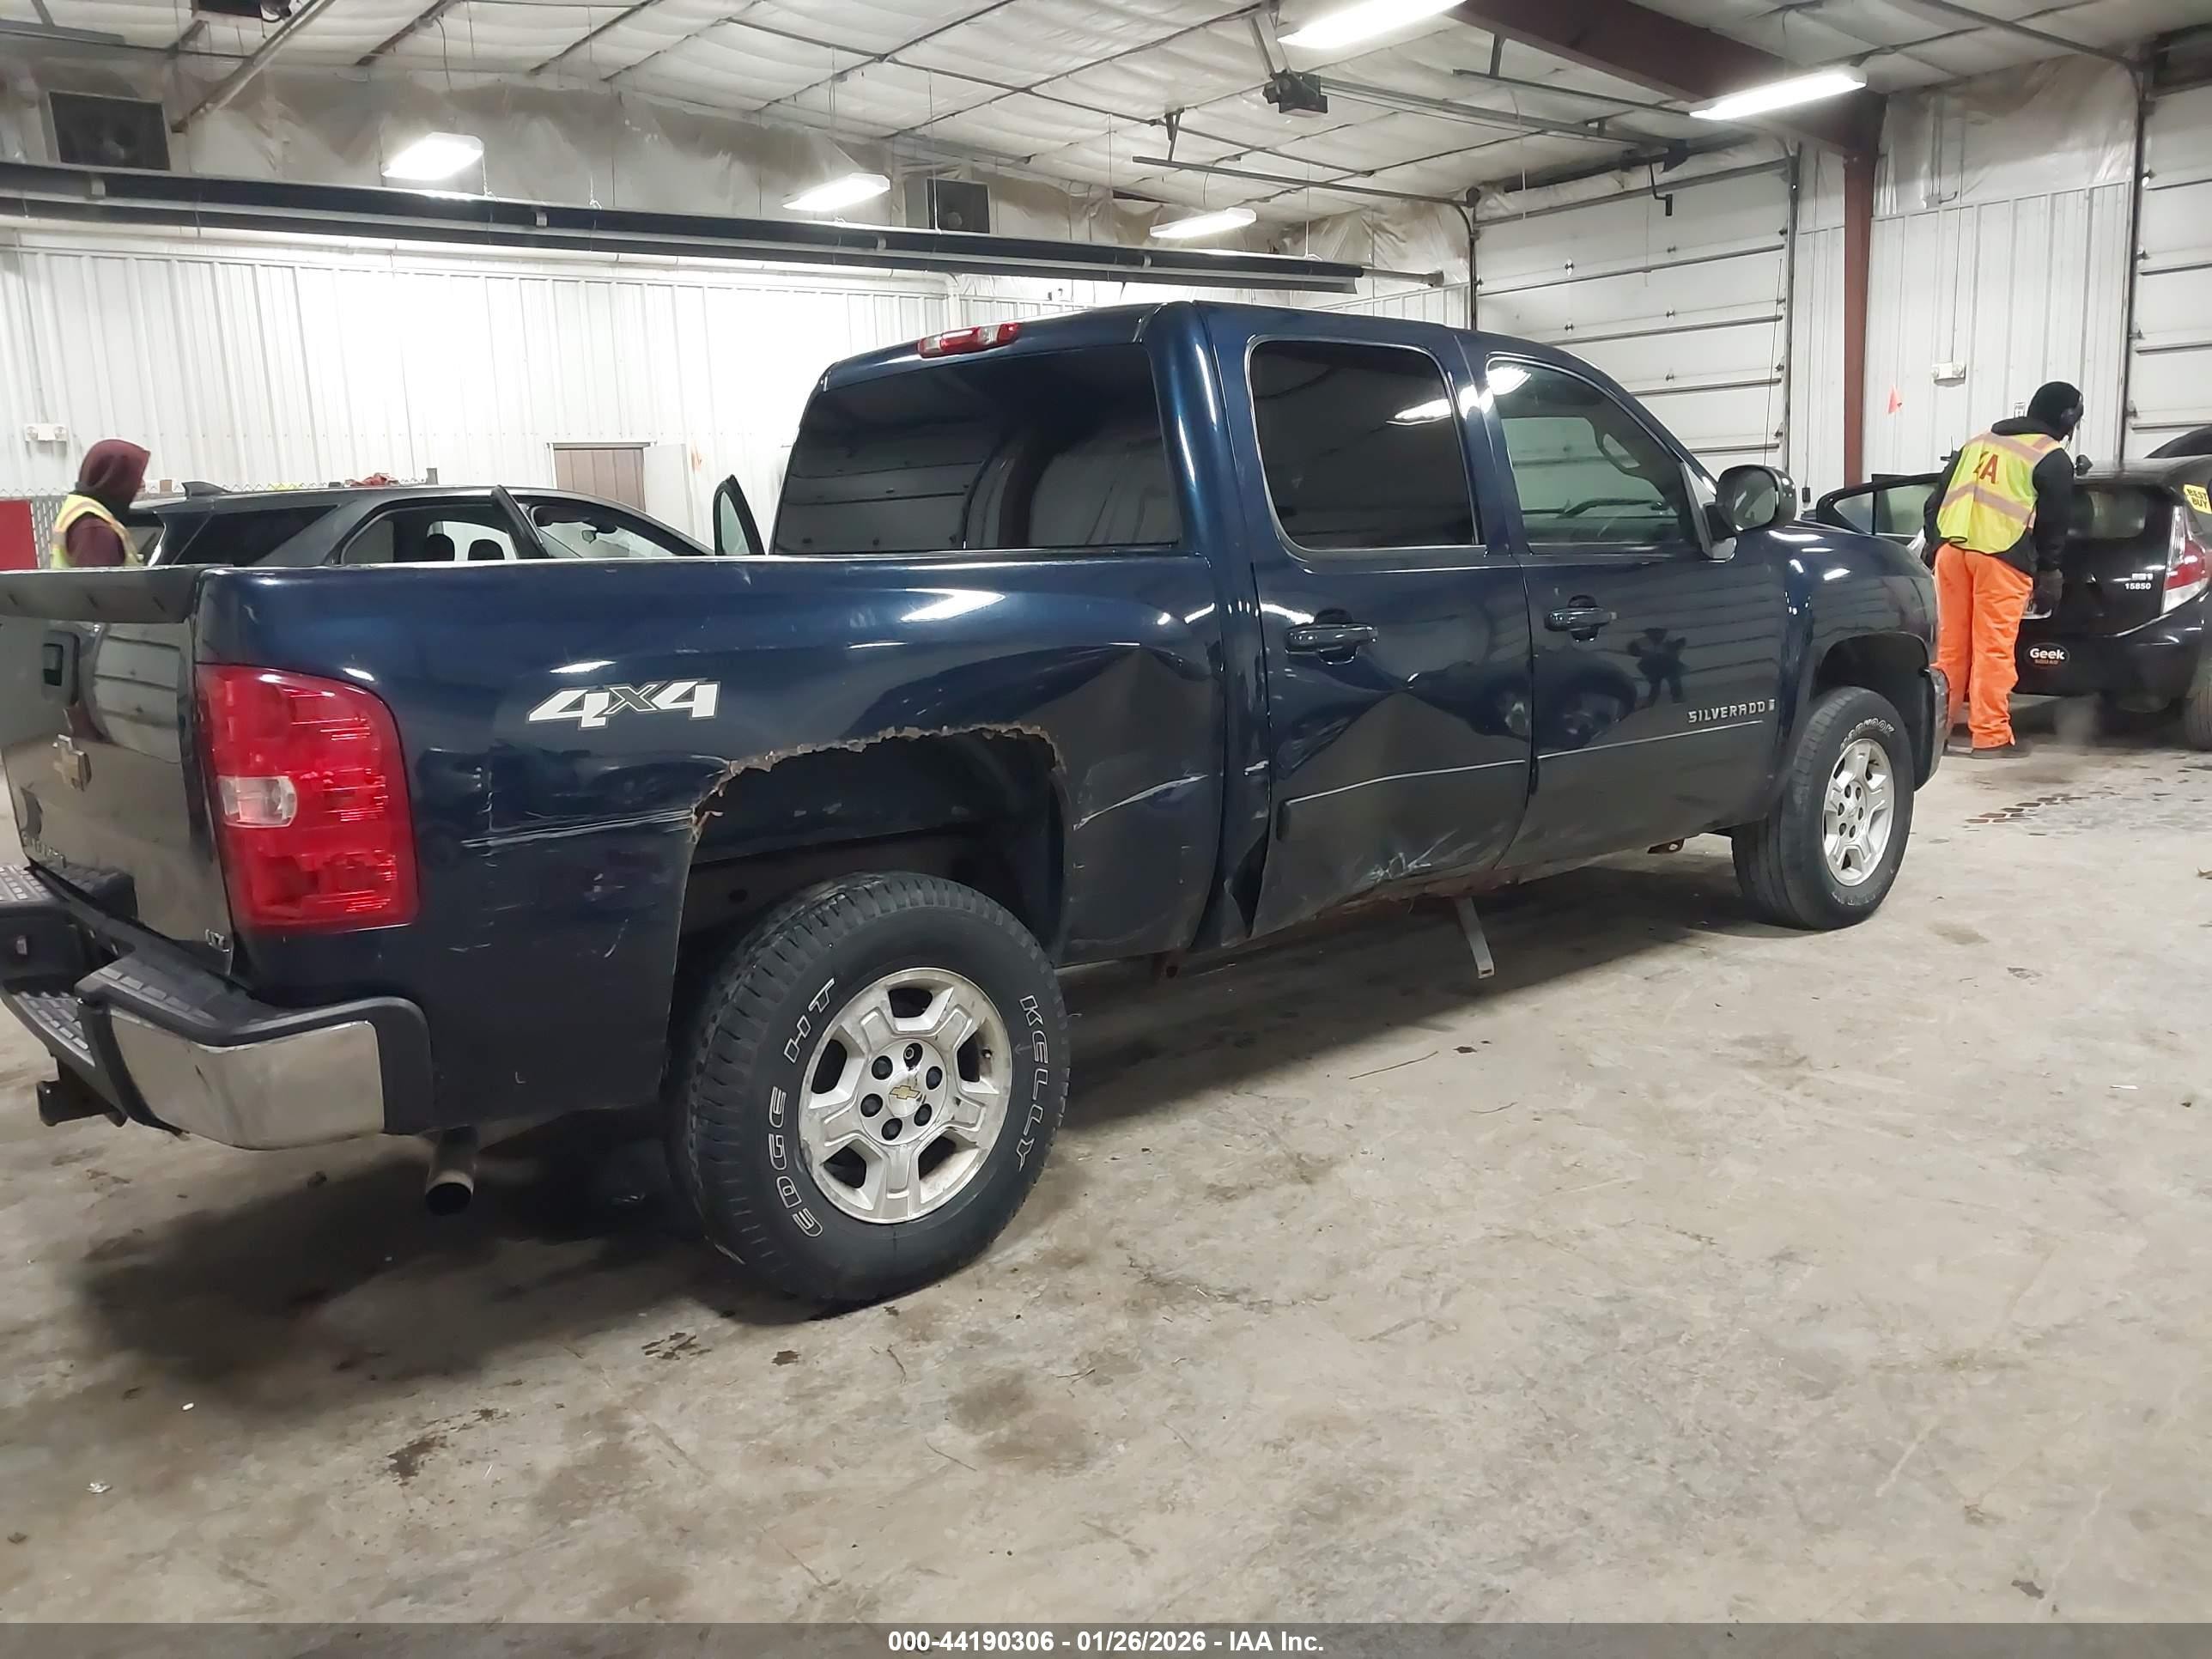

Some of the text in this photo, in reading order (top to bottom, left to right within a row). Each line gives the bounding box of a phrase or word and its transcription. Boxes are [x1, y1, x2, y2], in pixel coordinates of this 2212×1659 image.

[2187, 488, 2208, 501] BEST
[2191, 496, 2208, 509] BUY
[2030, 647, 2065, 659] Geek
[1687, 700, 1765, 724] SILVERADO
[1016, 994, 1049, 1172] KELLY
[769, 977, 835, 1237] EDGE HT
